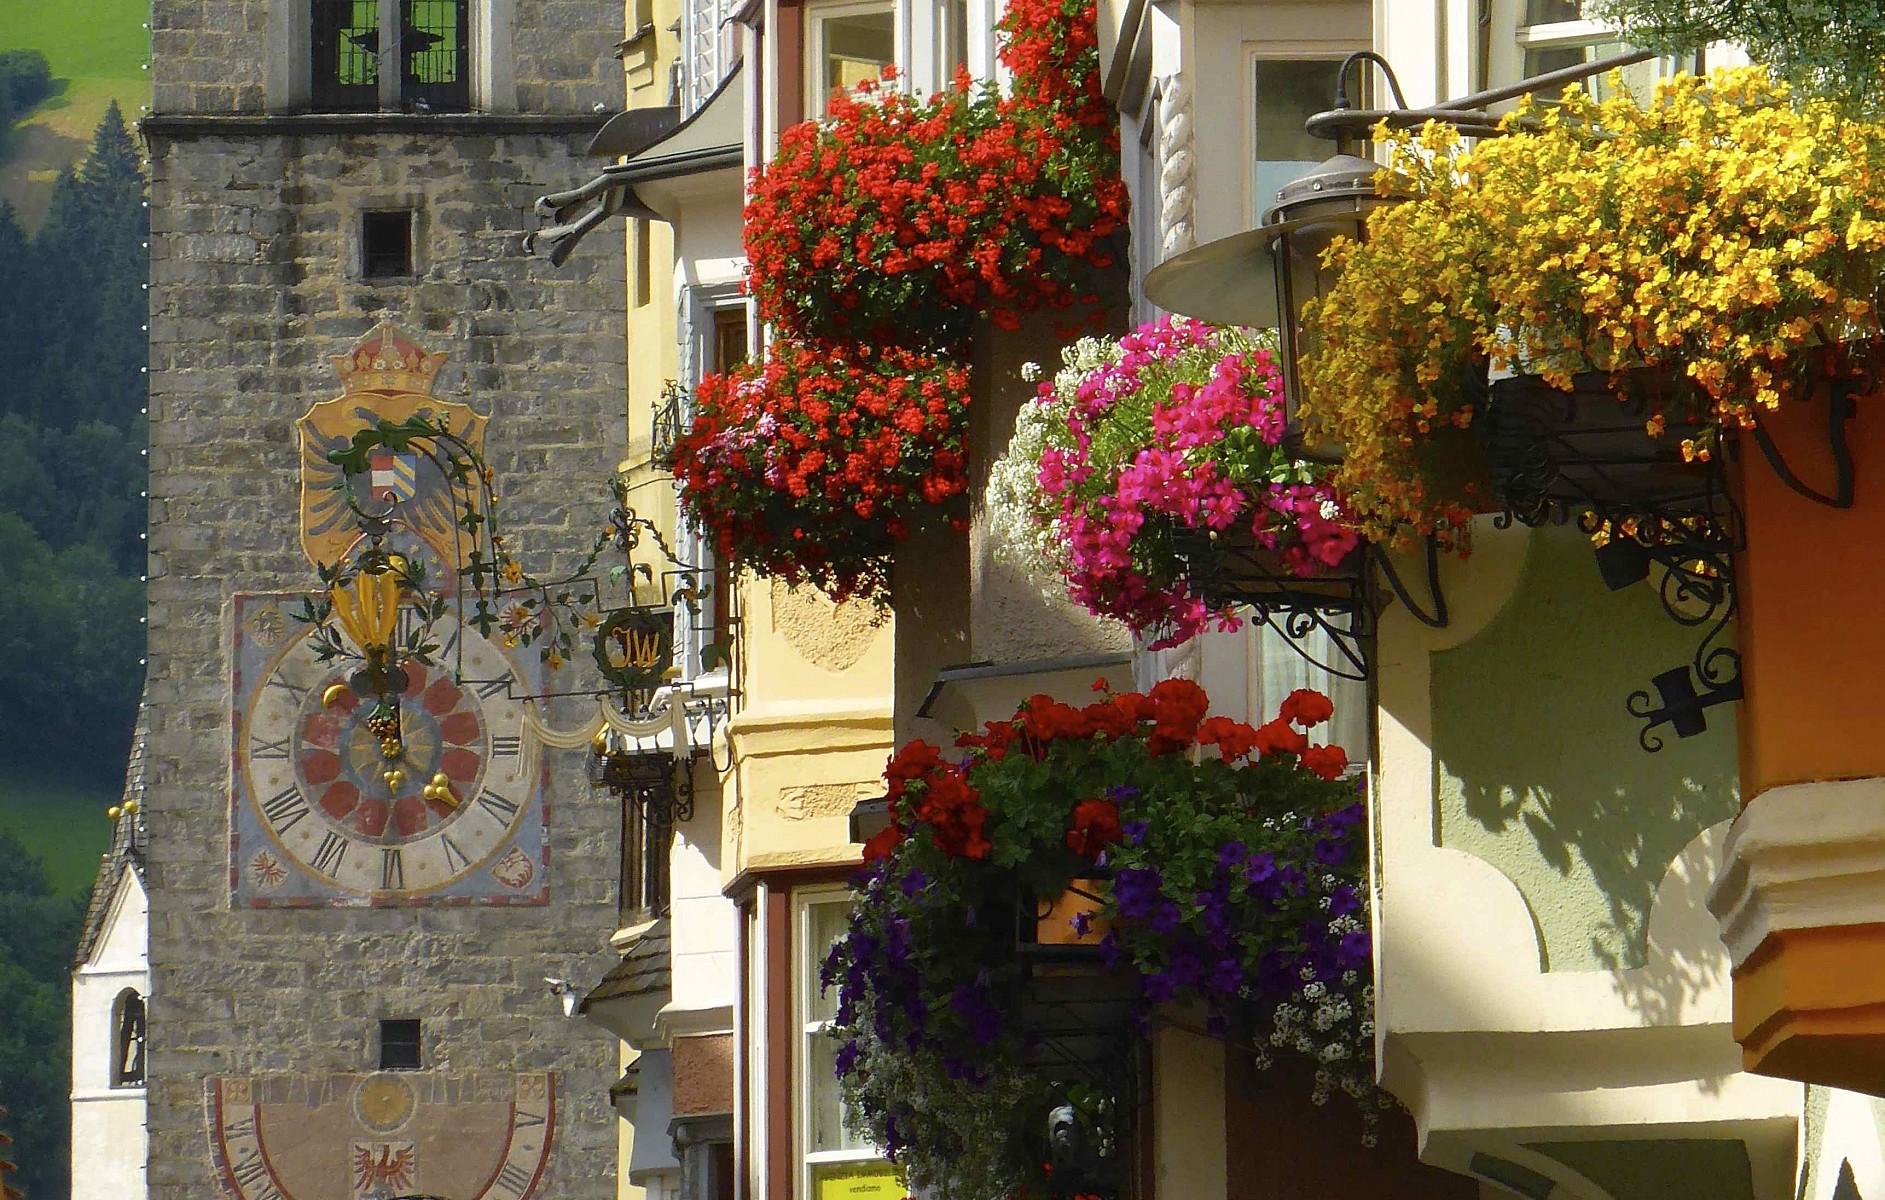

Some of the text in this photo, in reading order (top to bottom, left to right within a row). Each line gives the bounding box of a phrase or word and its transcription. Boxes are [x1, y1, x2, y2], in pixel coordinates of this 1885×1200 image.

[267, 667, 312, 707] X
[250, 733, 290, 763] IX
[491, 734, 520, 759] III
[261, 782, 310, 835] VIII
[475, 786, 519, 830] IV
[309, 829, 348, 878] VII
[379, 849, 405, 889] VI
[441, 834, 470, 873] V
